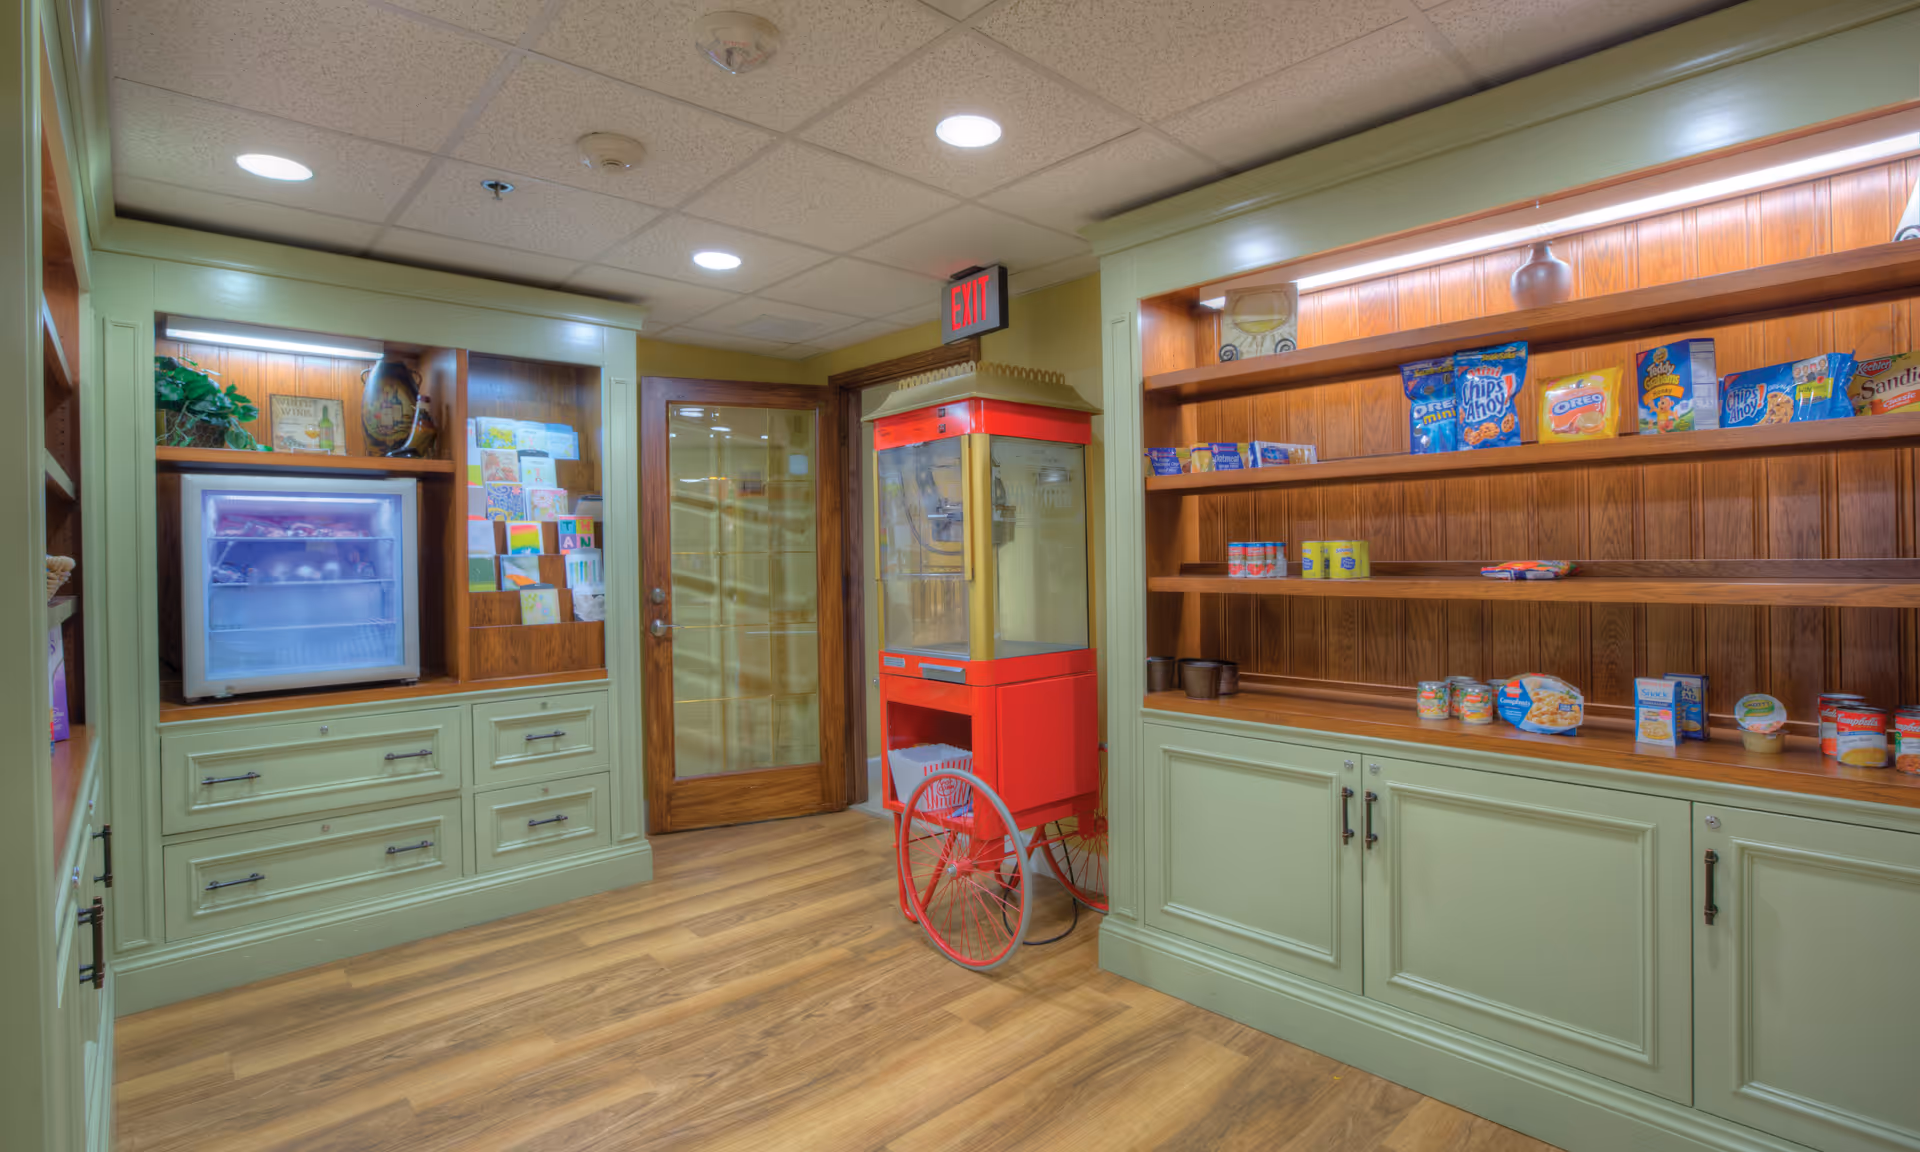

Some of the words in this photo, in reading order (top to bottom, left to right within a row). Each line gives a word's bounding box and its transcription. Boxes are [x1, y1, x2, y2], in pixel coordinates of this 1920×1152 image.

[951, 275, 989, 331] EXIT
[1648, 361, 1675, 378] Teddy
[1857, 359, 1891, 376] Keebler
[1463, 379, 1503, 406] Chips
[1644, 374, 1680, 391] Grahams
[1552, 393, 1603, 416] OREO
[1727, 389, 1758, 411] Chips
